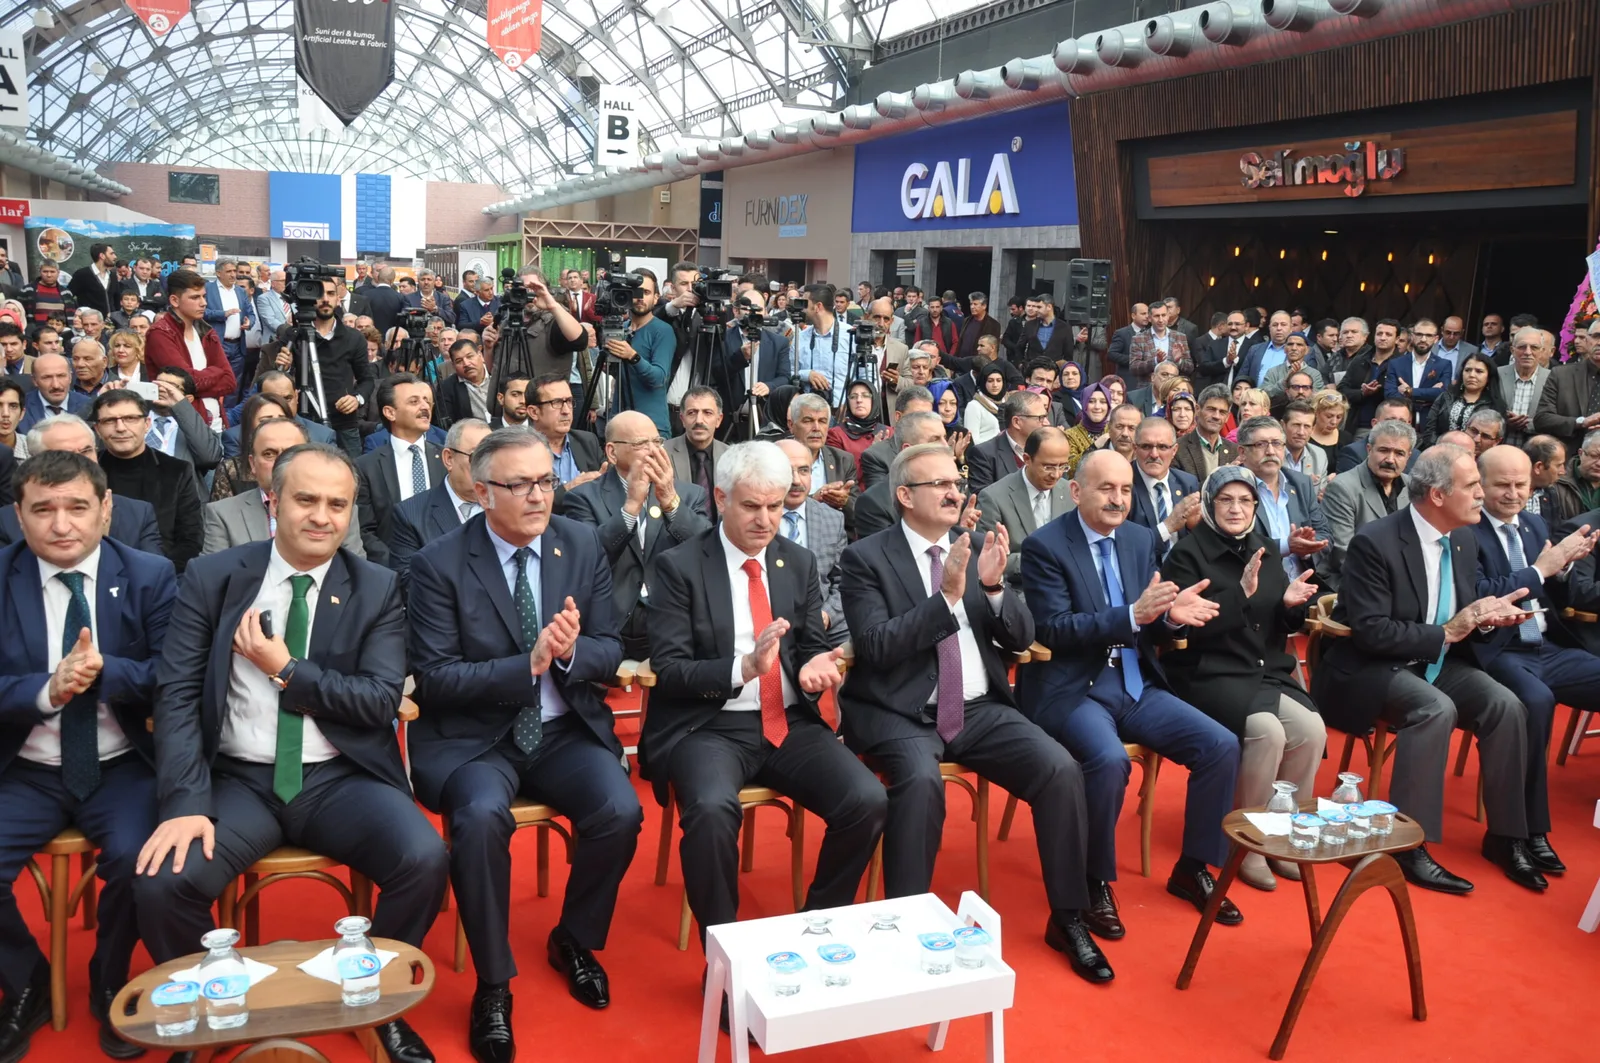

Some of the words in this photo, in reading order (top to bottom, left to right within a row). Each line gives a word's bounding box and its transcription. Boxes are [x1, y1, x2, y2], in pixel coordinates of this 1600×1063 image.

[303, 35, 331, 43] Artificial
[333, 37, 358, 46] Leather
[367, 40, 388, 48] Fabric
[315, 27, 330, 35] Suni
[331, 28, 345, 37] deri
[604, 100, 634, 111] HALL
[607, 115, 629, 140] B
[1240, 141, 1405, 198] Selimoğlu
[901, 152, 1020, 219] GALA
[0, 206, 23, 216] lar
[745, 194, 808, 226] FURNIDEX
